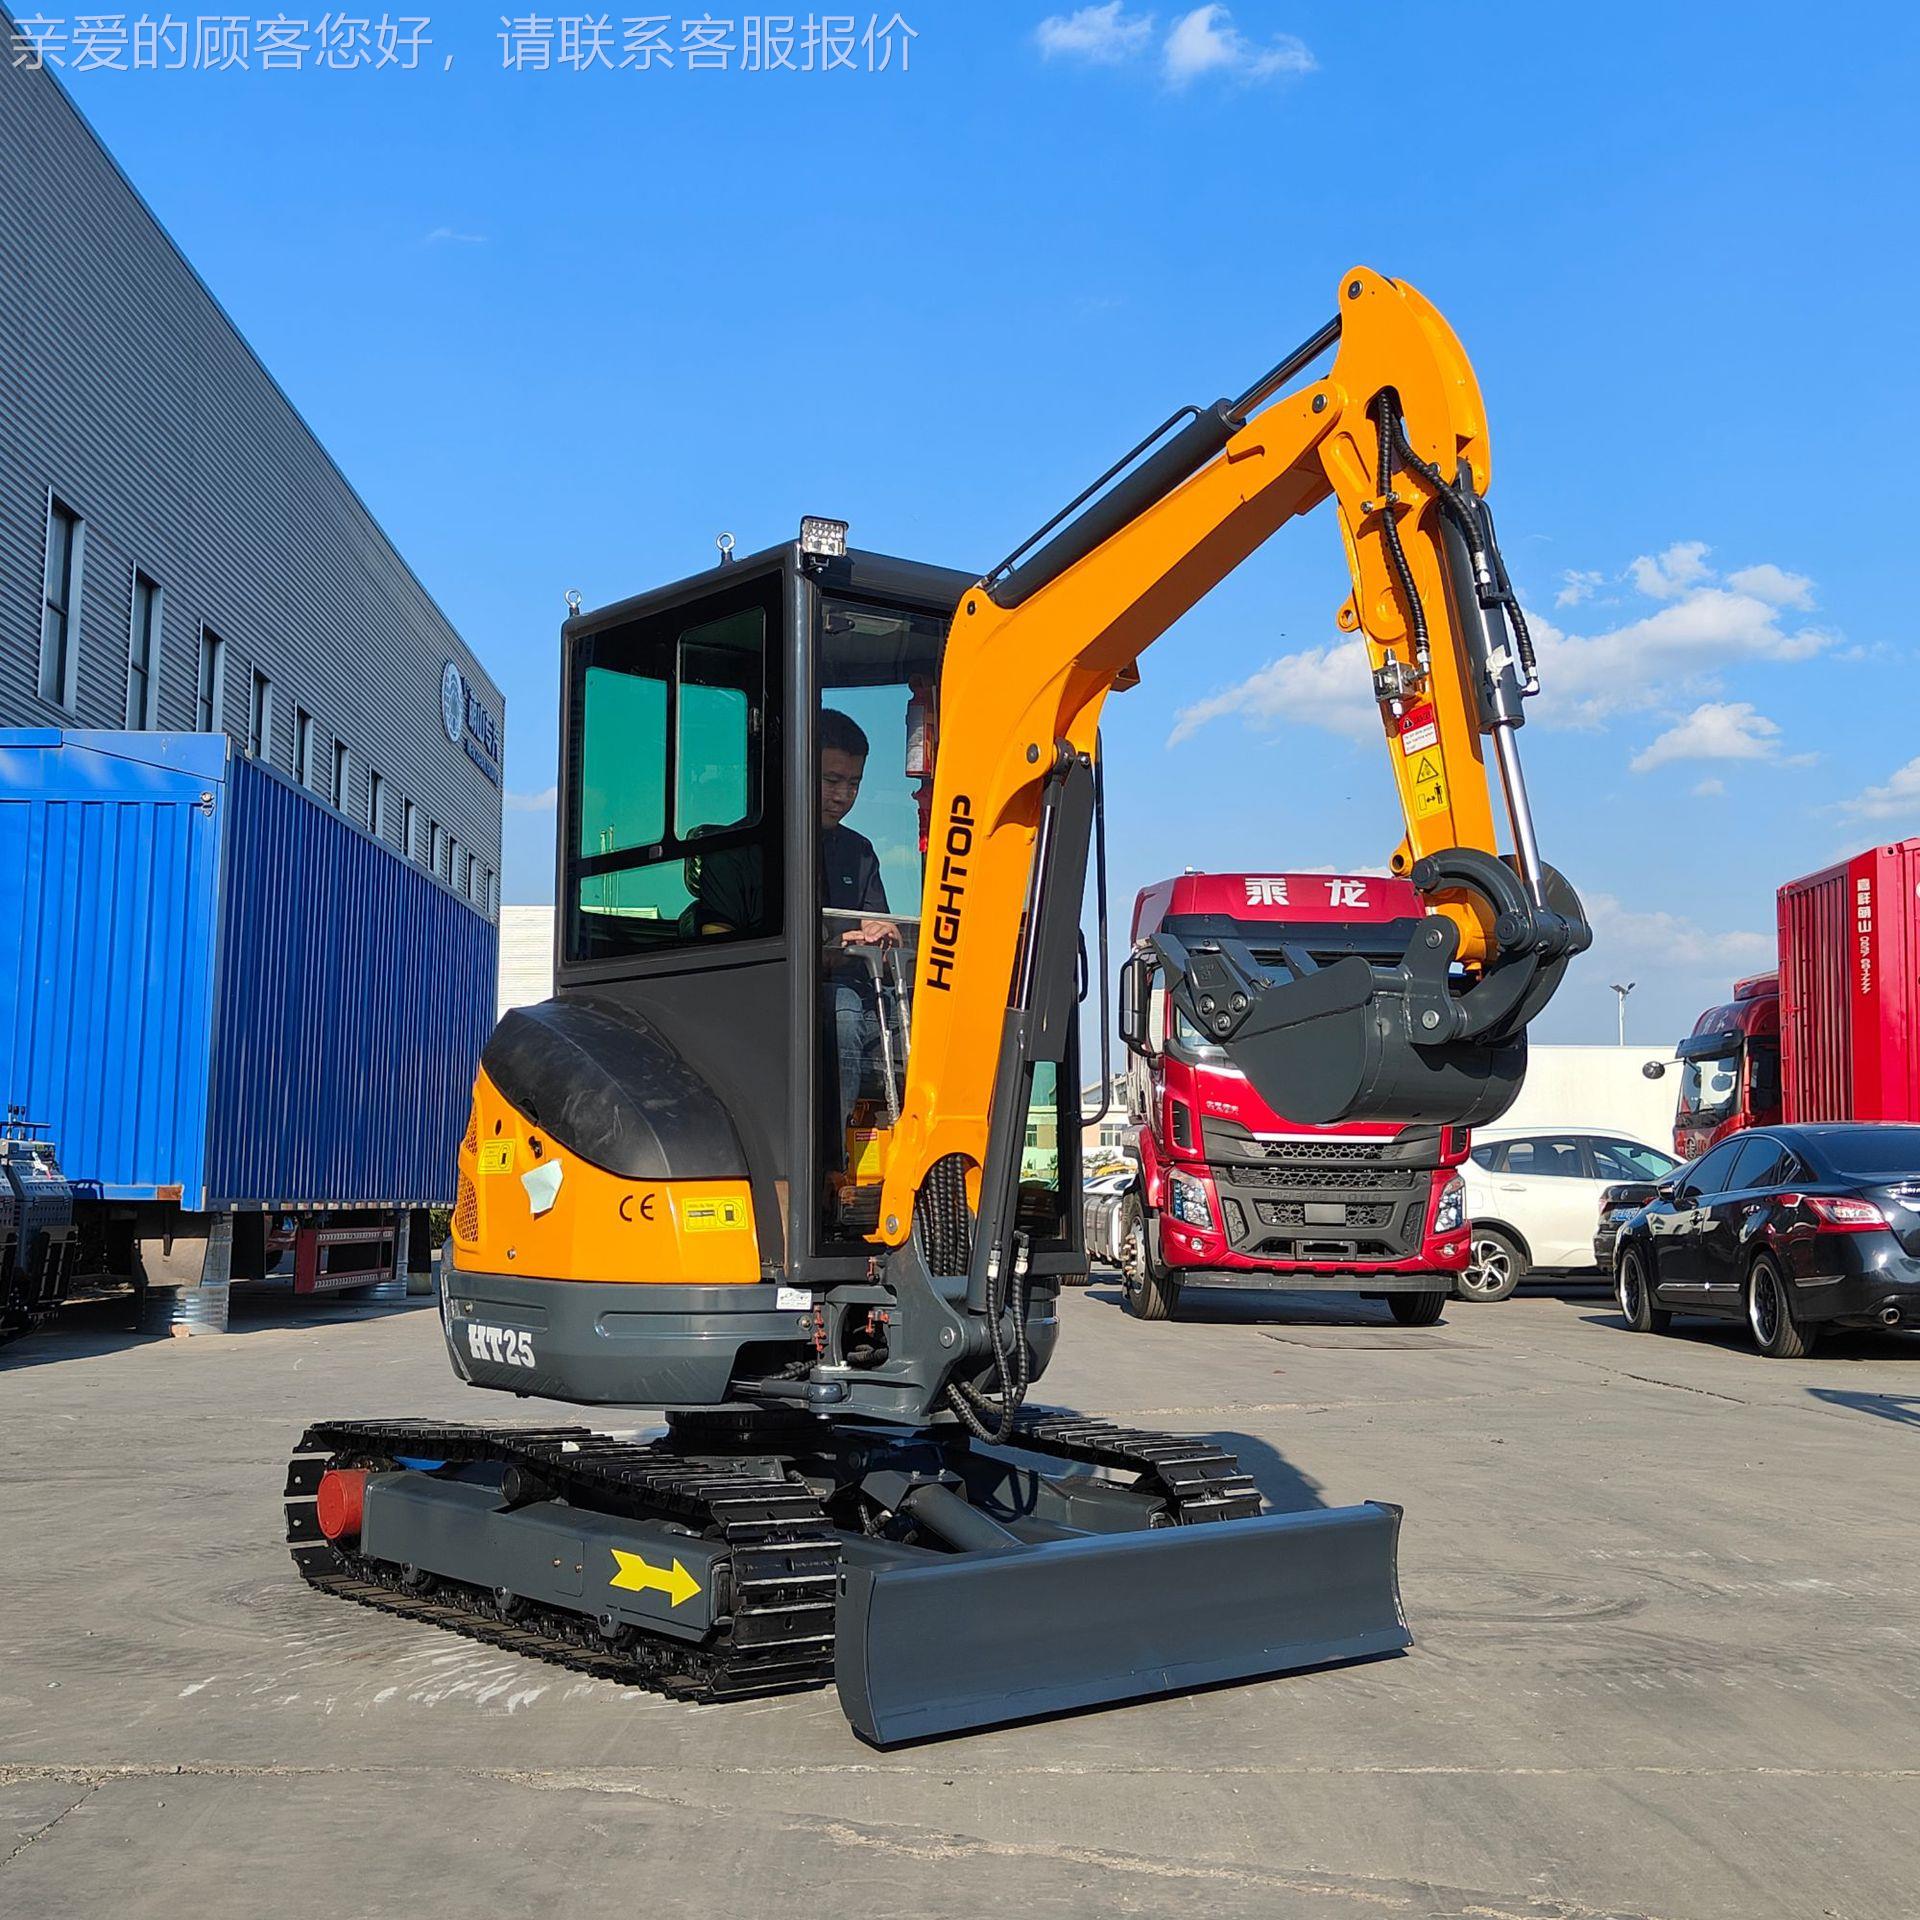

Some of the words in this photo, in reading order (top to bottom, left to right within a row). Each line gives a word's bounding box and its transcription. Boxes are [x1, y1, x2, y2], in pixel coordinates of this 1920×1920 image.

[927, 795, 974, 991] HIGHTOP
[1244, 877, 1370, 908] 乘龙
[619, 1194, 655, 1221] CE
[467, 1323, 536, 1368] HT25
